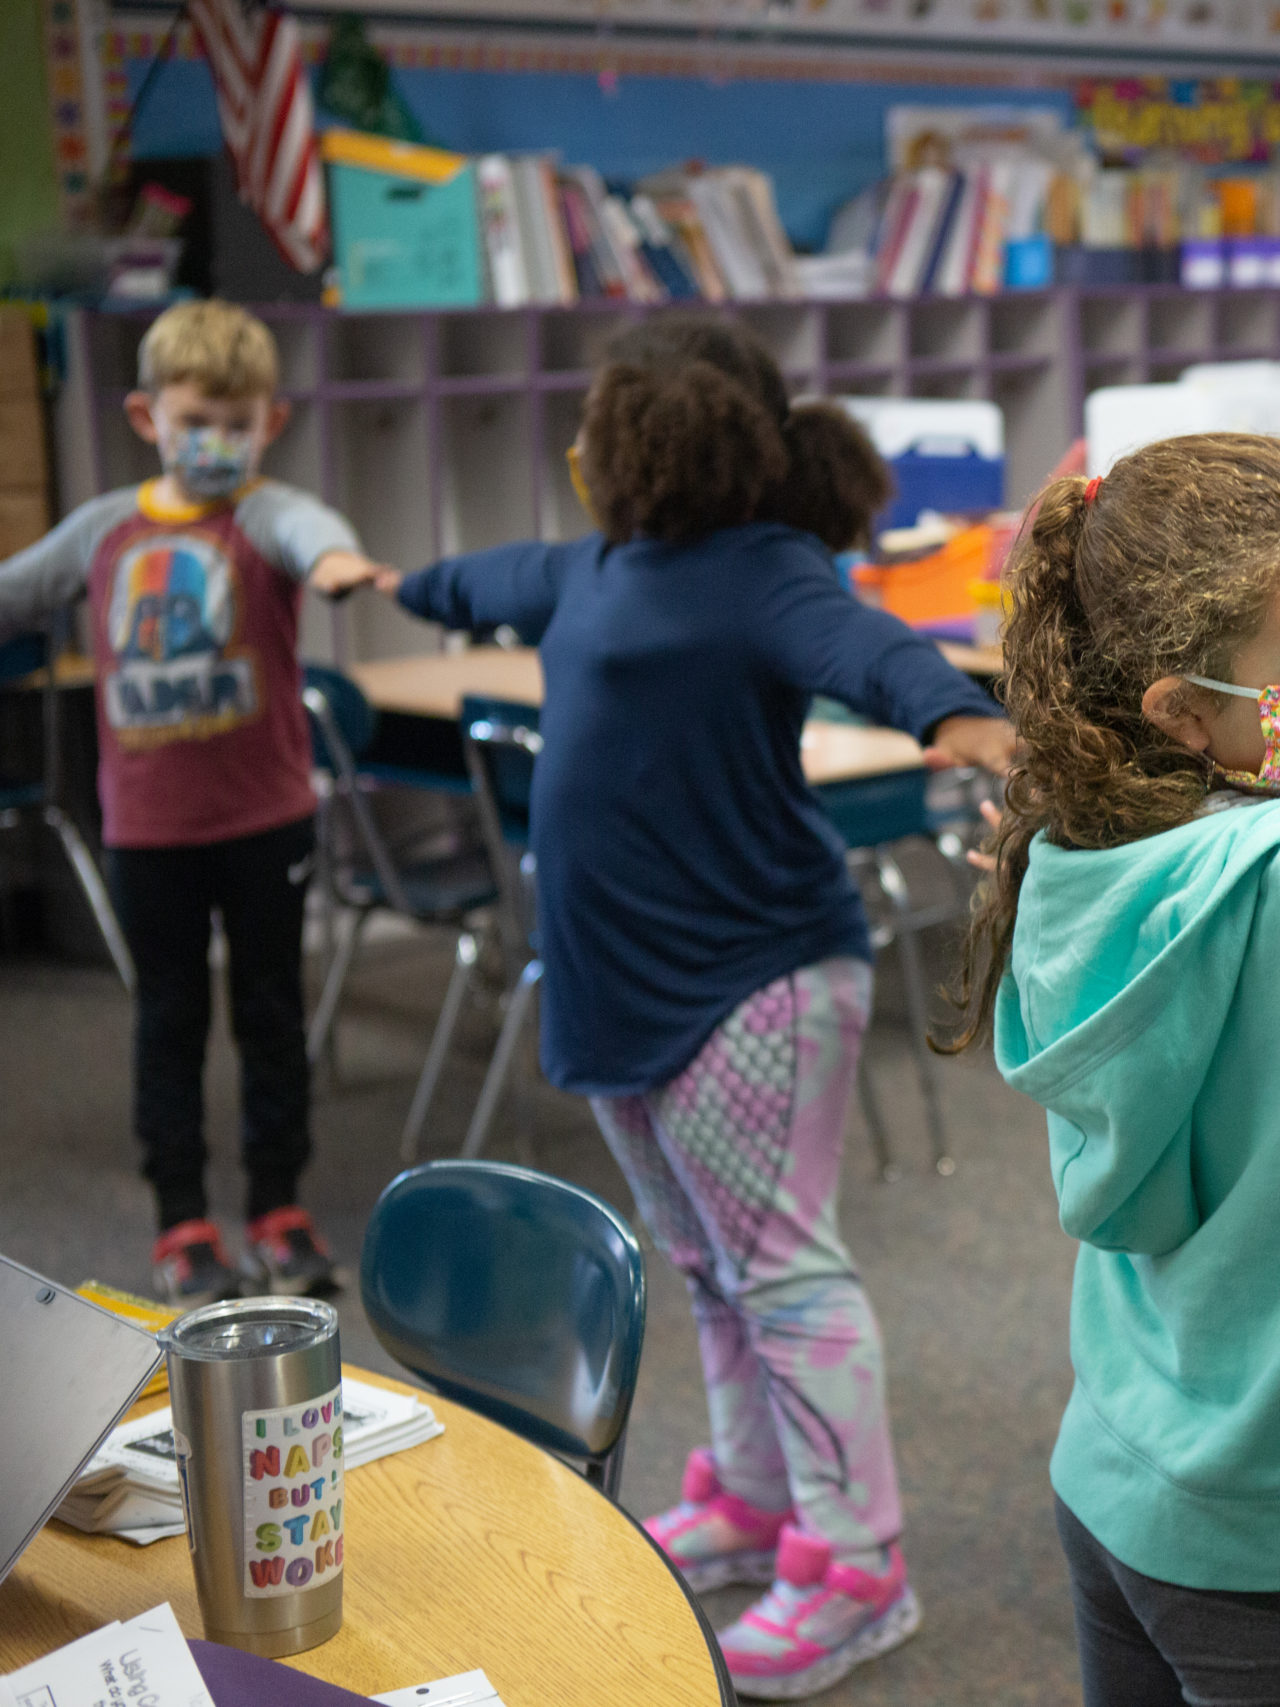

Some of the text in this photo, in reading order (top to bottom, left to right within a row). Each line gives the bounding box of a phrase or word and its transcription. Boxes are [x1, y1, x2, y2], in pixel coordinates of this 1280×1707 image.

[255, 1395, 342, 1440] I LOVE
[249, 1425, 344, 1481] NAPS
[268, 1476, 325, 1510] BUT
[255, 1498, 343, 1553] STAY
[249, 1533, 344, 1589] WOKE
